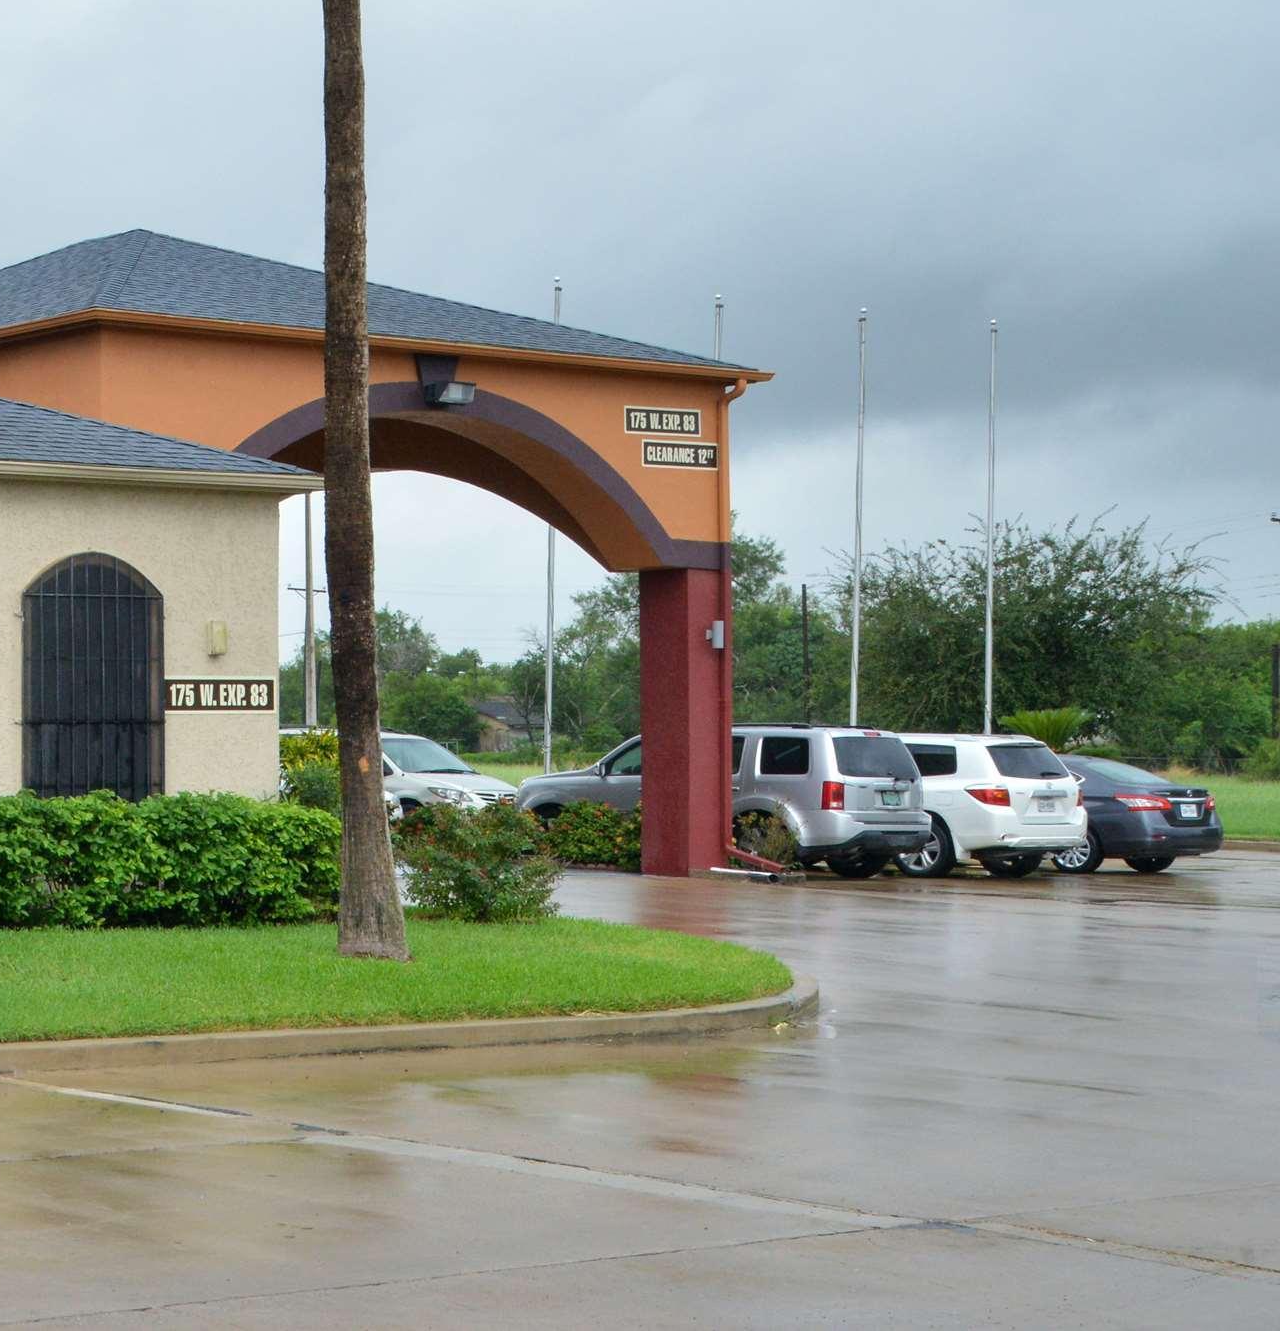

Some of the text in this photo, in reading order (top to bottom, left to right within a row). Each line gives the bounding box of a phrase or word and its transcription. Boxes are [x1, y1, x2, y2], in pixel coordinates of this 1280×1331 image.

[630, 412, 646, 429] 175
[649, 413, 661, 430] W.
[683, 415, 695, 431] 83
[647, 446, 695, 464] CLEARANCE
[170, 683, 268, 707] 175 W. EXP. 83
